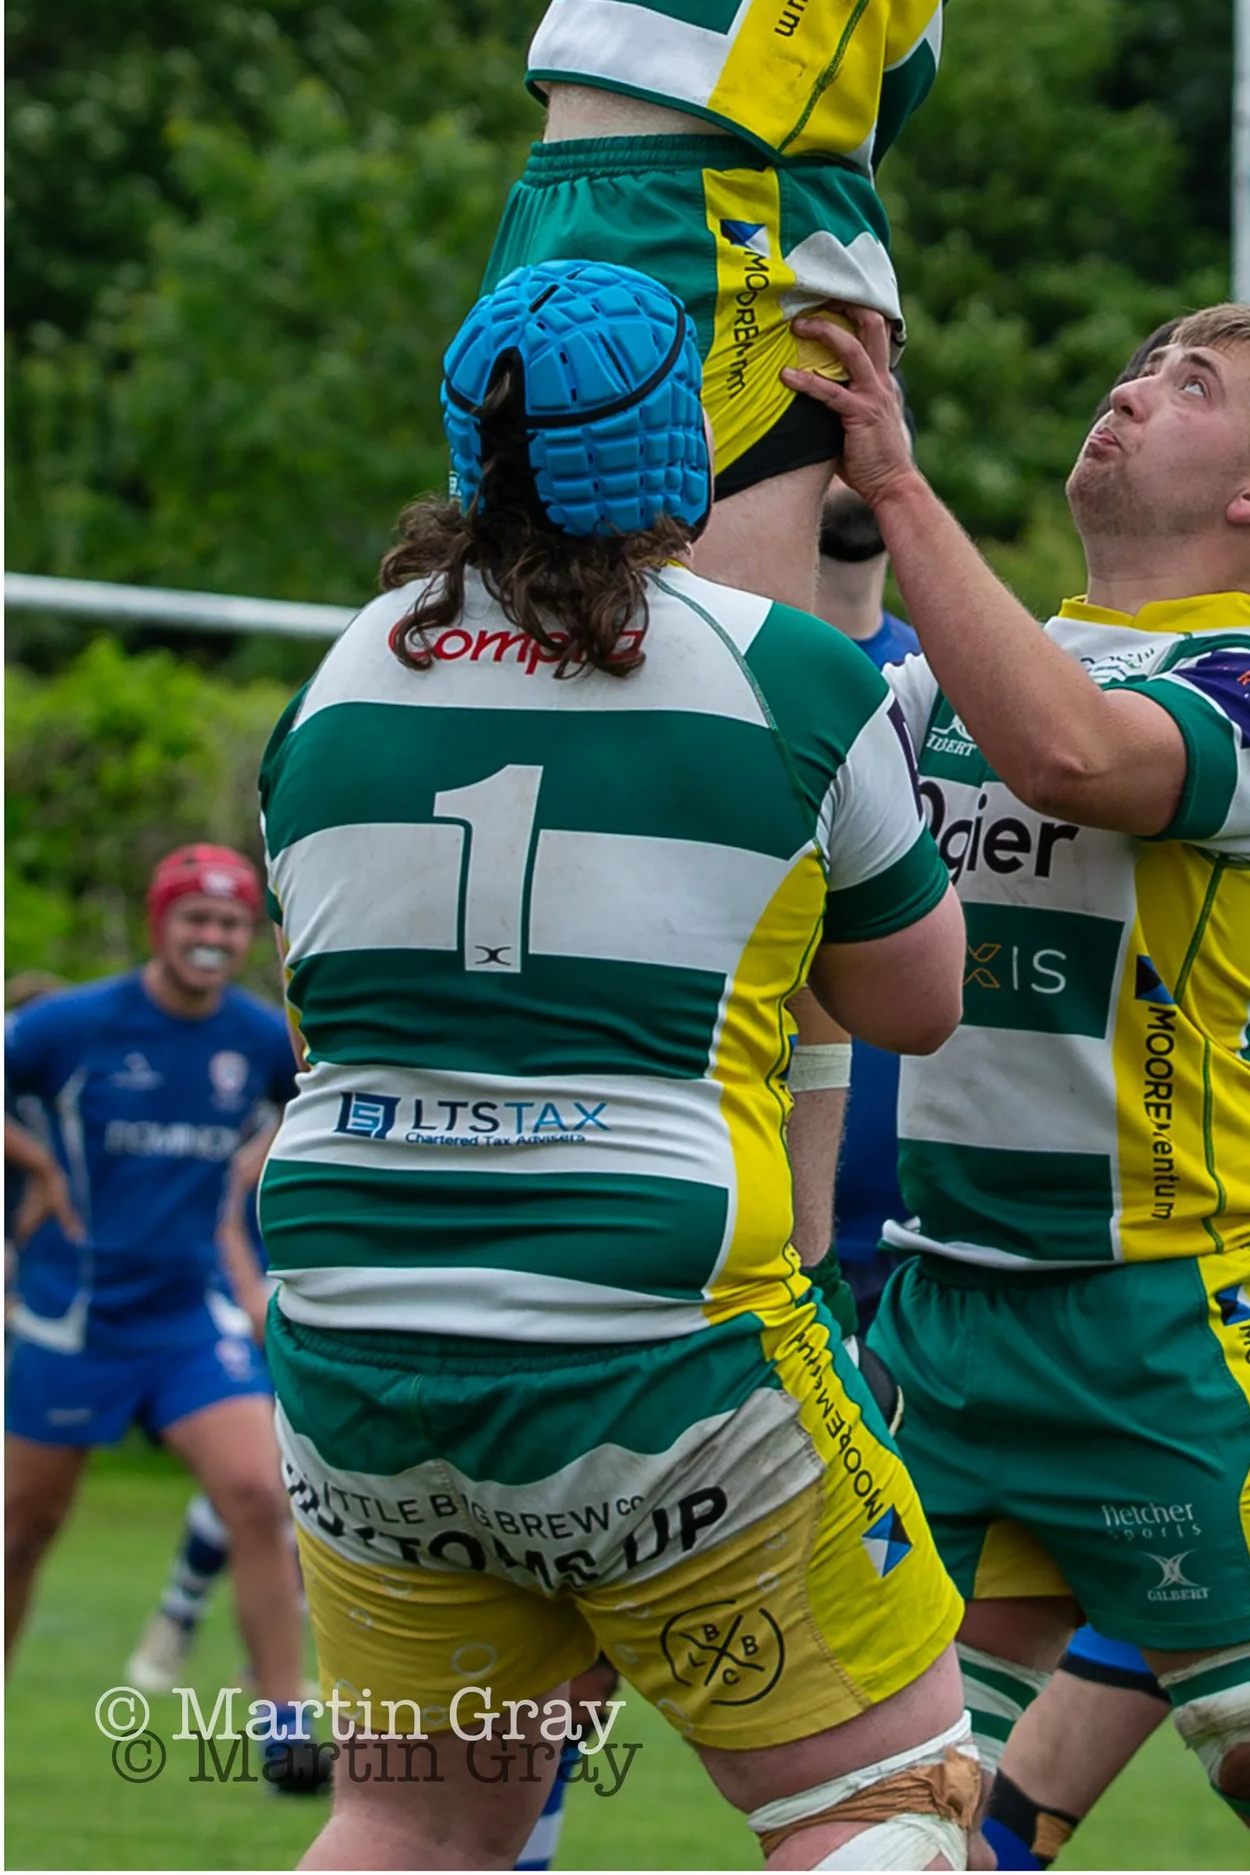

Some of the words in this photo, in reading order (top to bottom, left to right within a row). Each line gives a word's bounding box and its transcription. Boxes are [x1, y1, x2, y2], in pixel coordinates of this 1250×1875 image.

[433, 763, 543, 973] 1
[405, 1132, 478, 1147] Chartered
[481, 1135, 511, 1147] Tax
[494, 1502, 610, 1541] BREW
[624, 1485, 728, 1570] UP
[1147, 1586, 1211, 1602] GILBERT
